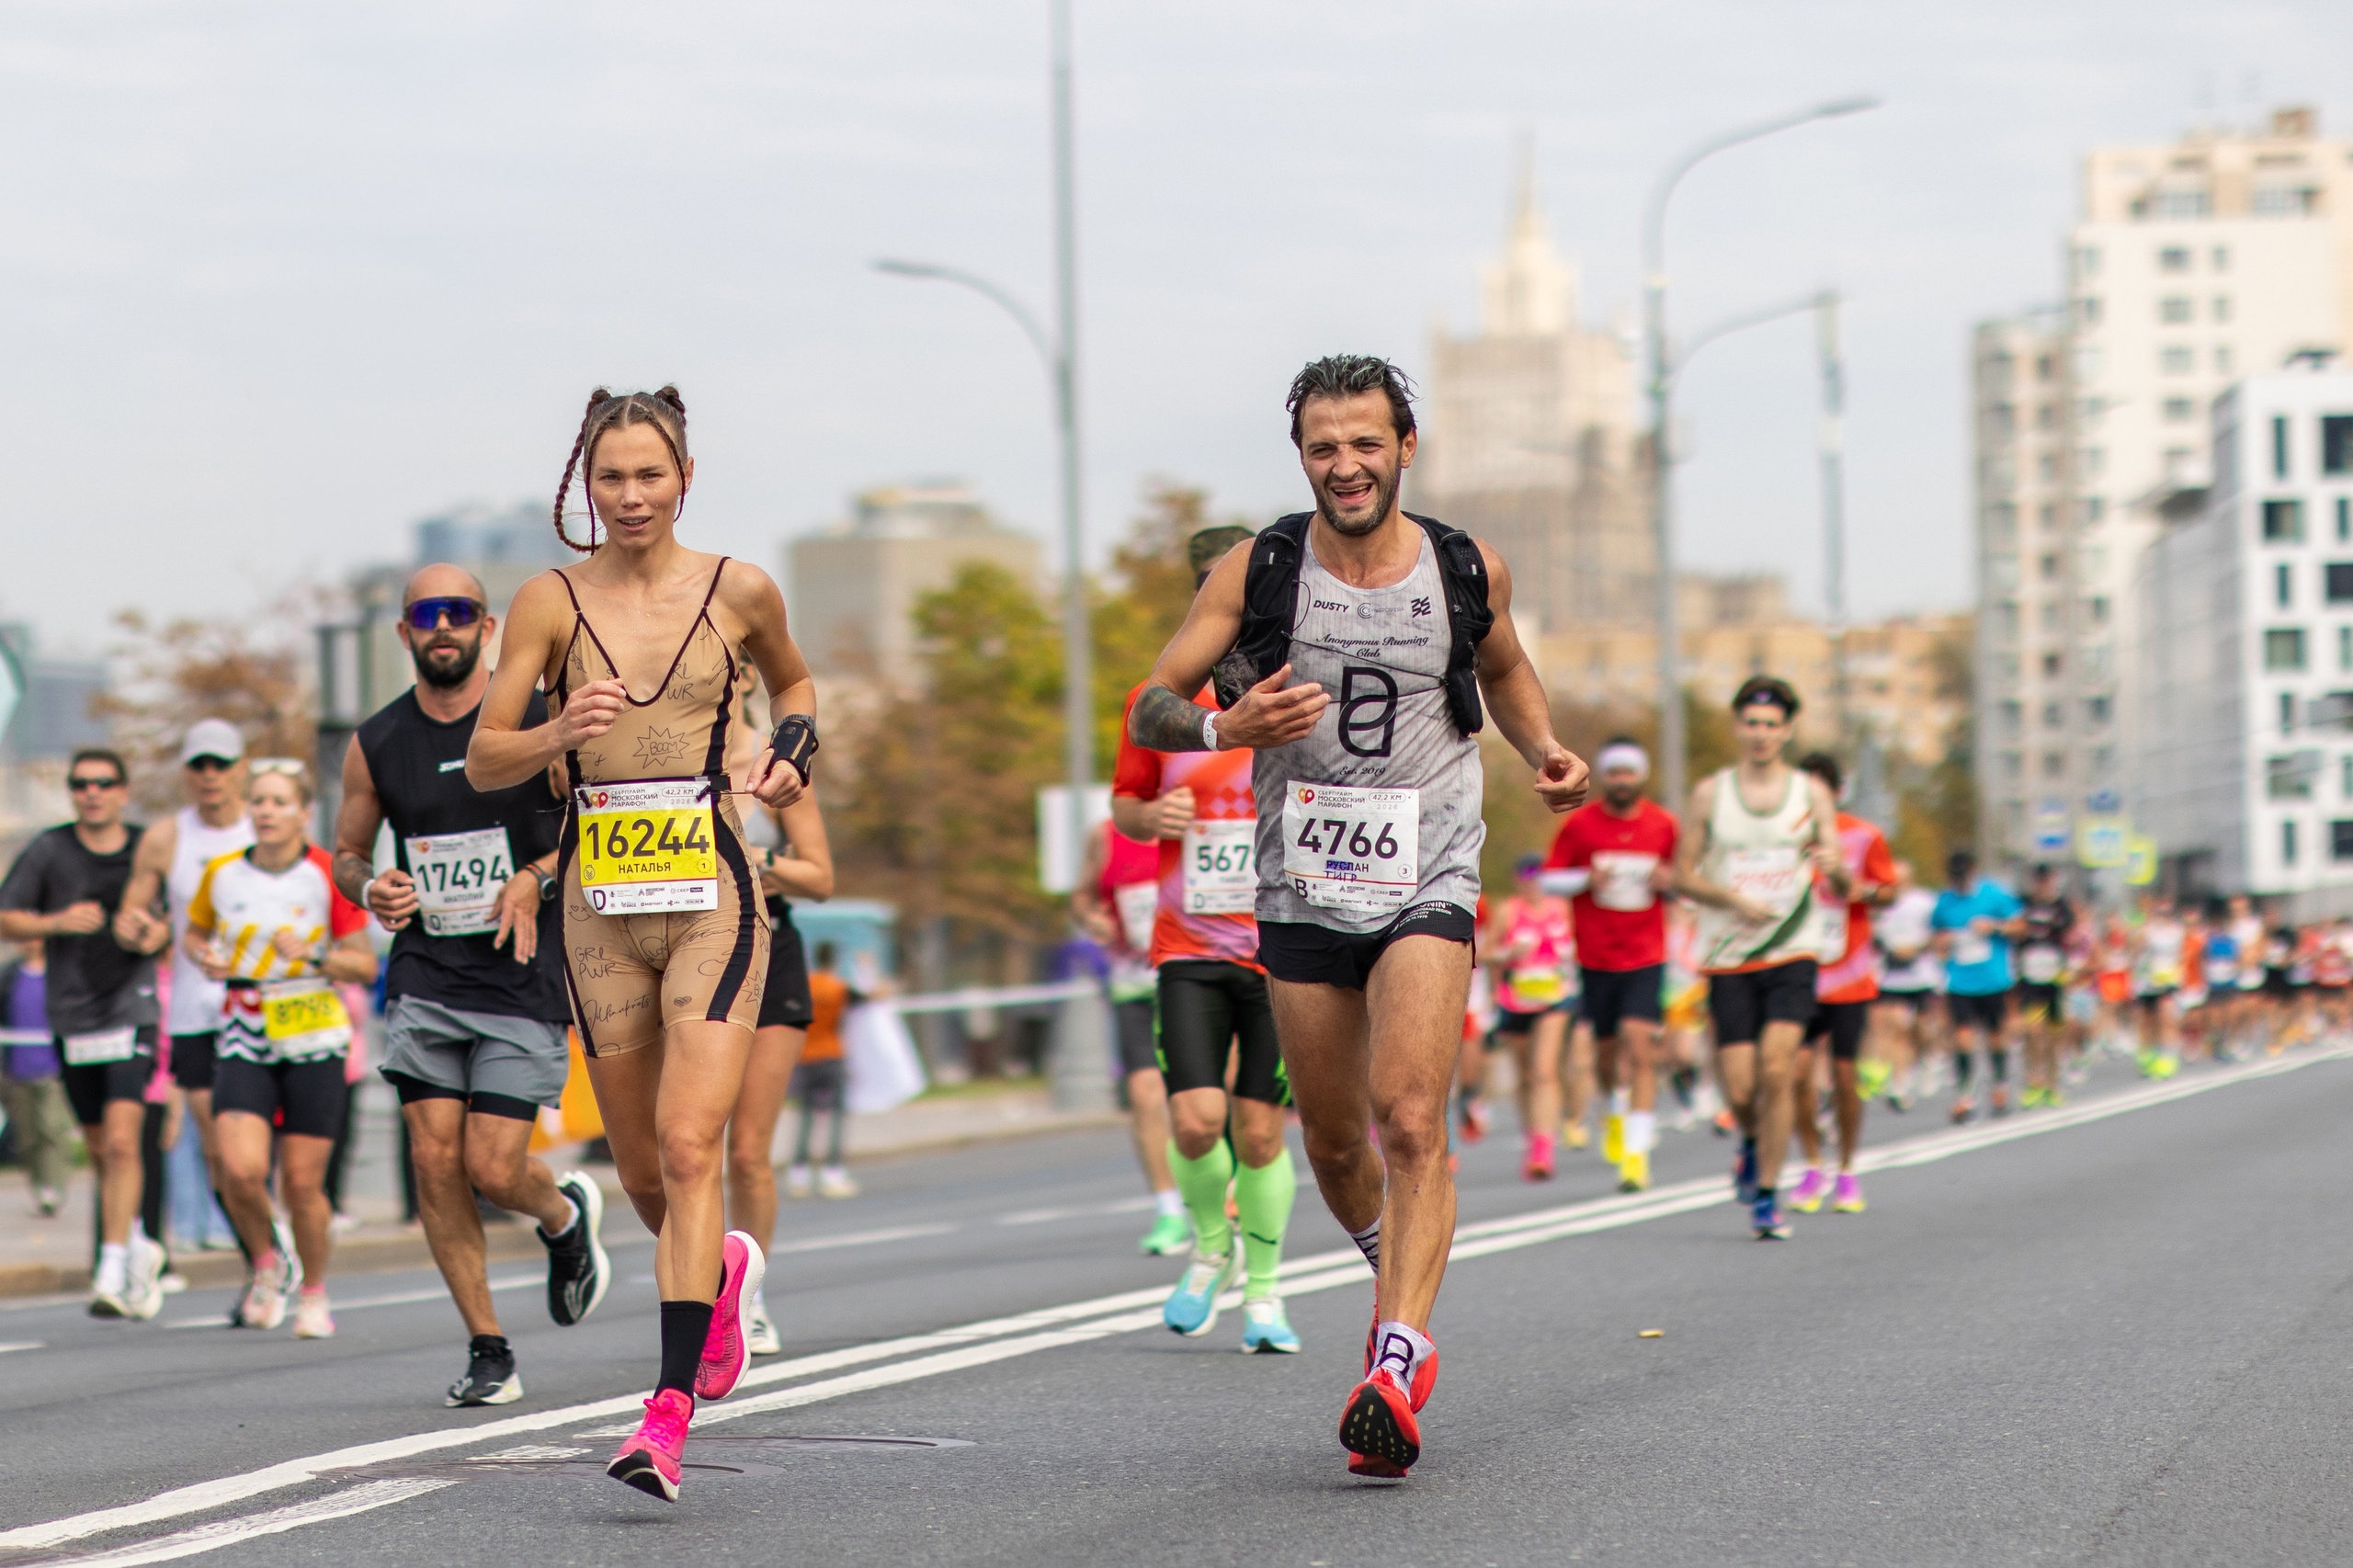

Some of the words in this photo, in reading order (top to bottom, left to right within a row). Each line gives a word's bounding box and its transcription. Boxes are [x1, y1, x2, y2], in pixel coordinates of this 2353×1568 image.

[1313, 600, 1350, 613] DUSTY
[1316, 633, 1381, 648] Anonymous
[1382, 635, 1429, 647] Running
[1356, 648, 1381, 658] Club
[649, 741, 677, 755] BOOM
[1340, 766, 1358, 776] Est.
[1360, 767, 1387, 777] 2019
[586, 817, 710, 860] 16244
[1297, 818, 1398, 859] 4766
[1197, 845, 1256, 872] 567
[417, 855, 509, 892] 17494
[618, 862, 671, 874] НАТАЛЬЯ
[1324, 870, 1357, 883] ТИГР
[1295, 878, 1308, 899] B
[593, 890, 607, 911] D
[1194, 893, 1205, 908] D
[430, 915, 441, 930] D
